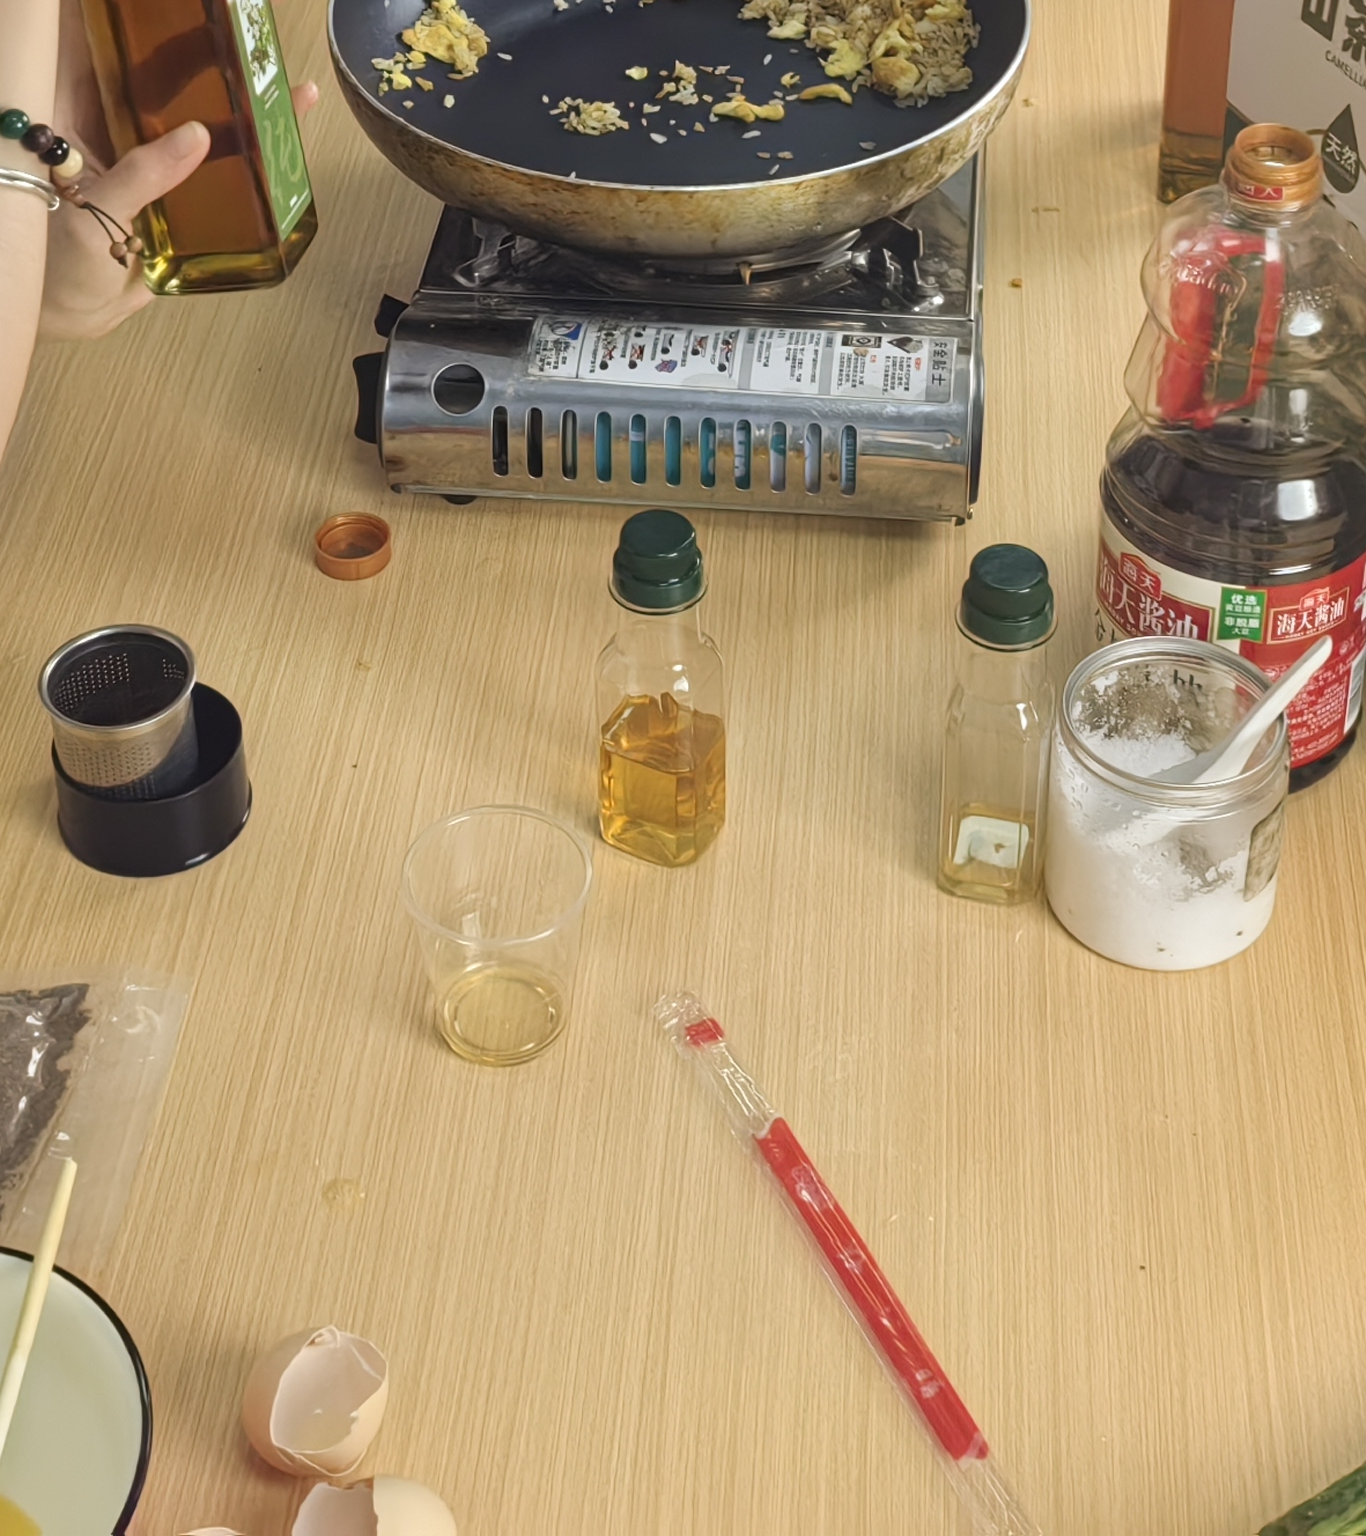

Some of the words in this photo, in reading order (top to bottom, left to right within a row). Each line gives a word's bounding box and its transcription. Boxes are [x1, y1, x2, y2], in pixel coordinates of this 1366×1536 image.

[1325, 131, 1357, 175] 天然
[1231, 594, 1257, 605] 优选
[1277, 597, 1344, 636] 海天酱油
